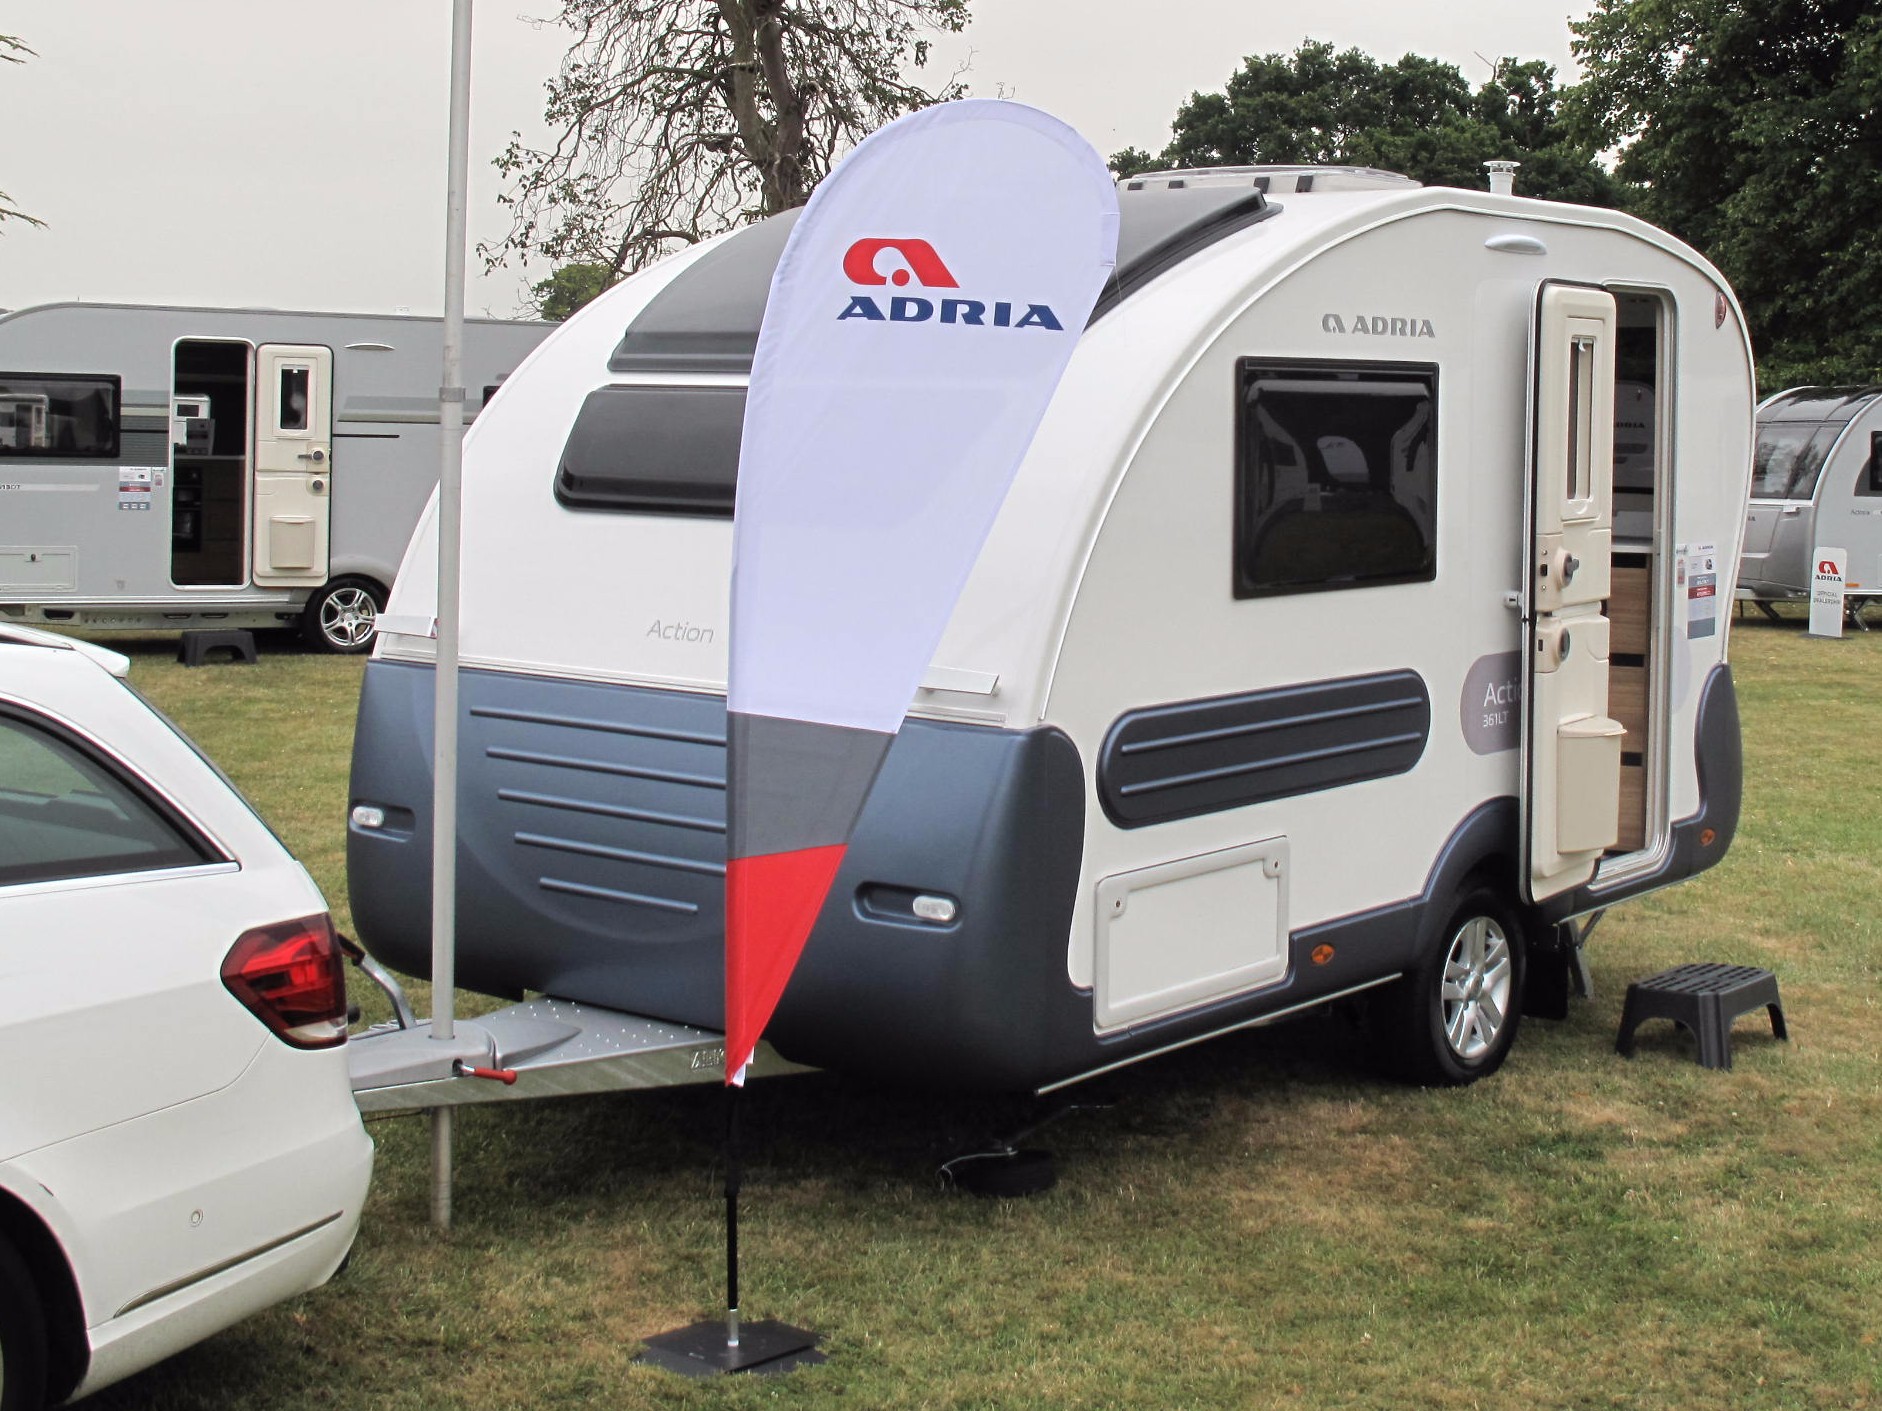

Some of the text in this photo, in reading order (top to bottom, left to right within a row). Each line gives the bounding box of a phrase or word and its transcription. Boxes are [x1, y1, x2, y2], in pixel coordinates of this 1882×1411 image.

[836, 296, 1064, 331] ADRIA
[1352, 315, 1436, 338] ADRIA
[1815, 574, 1842, 582] ADRIA
[646, 619, 714, 643] Action
[1483, 676, 1521, 707] Acti
[1483, 711, 1509, 727] 361LT
